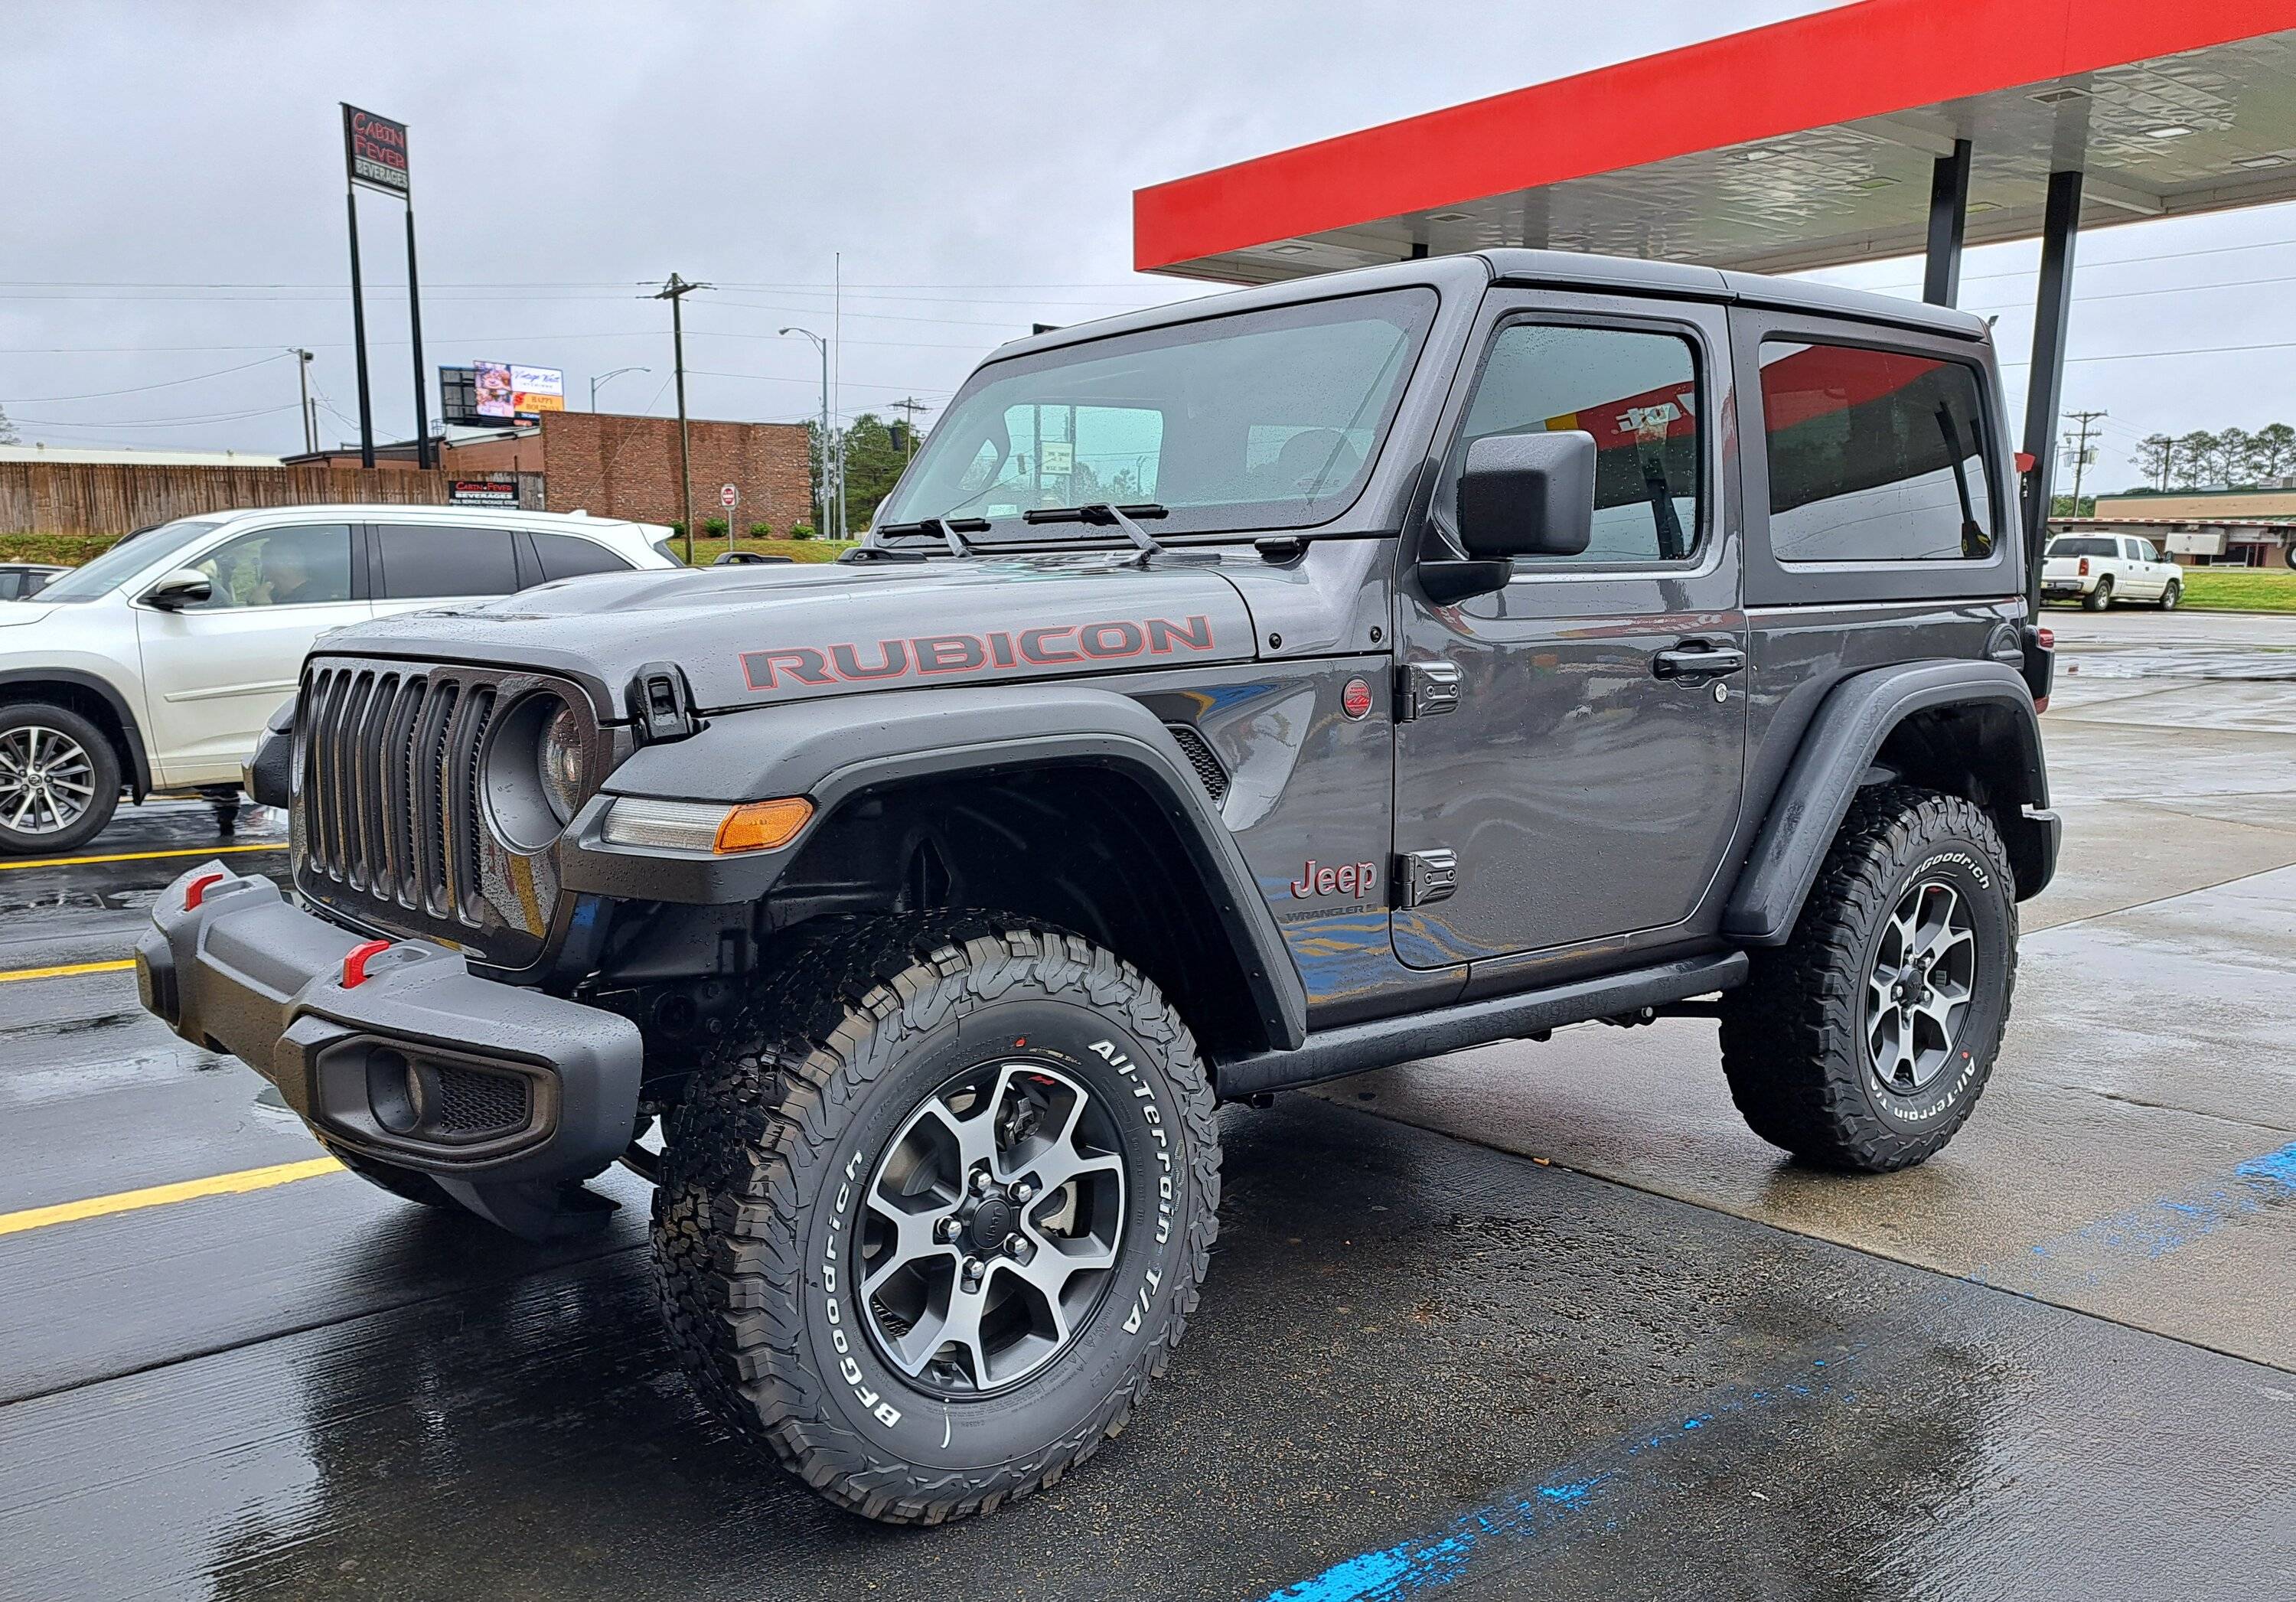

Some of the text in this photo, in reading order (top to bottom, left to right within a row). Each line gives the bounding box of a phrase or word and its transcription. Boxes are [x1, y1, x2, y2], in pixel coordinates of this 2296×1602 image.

[354, 113, 404, 148] CABIN
[354, 134, 405, 168] FEVER
[355, 159, 407, 188] BEVERAGES
[487, 483, 512, 491] FEVER
[739, 615, 1215, 691] RUBICON
[1290, 860, 1377, 899] Jeep
[1900, 852, 1990, 896] BFGoodrich
[1286, 905, 1363, 922] WRANGLER
[1871, 1075, 1888, 1111] T/A
[1894, 1056, 1975, 1123] All-Terrain
[1088, 1041, 1173, 1245] All-Terrain
[822, 1150, 902, 1428] BFGoodrich
[1121, 1268, 1163, 1335] T/A
